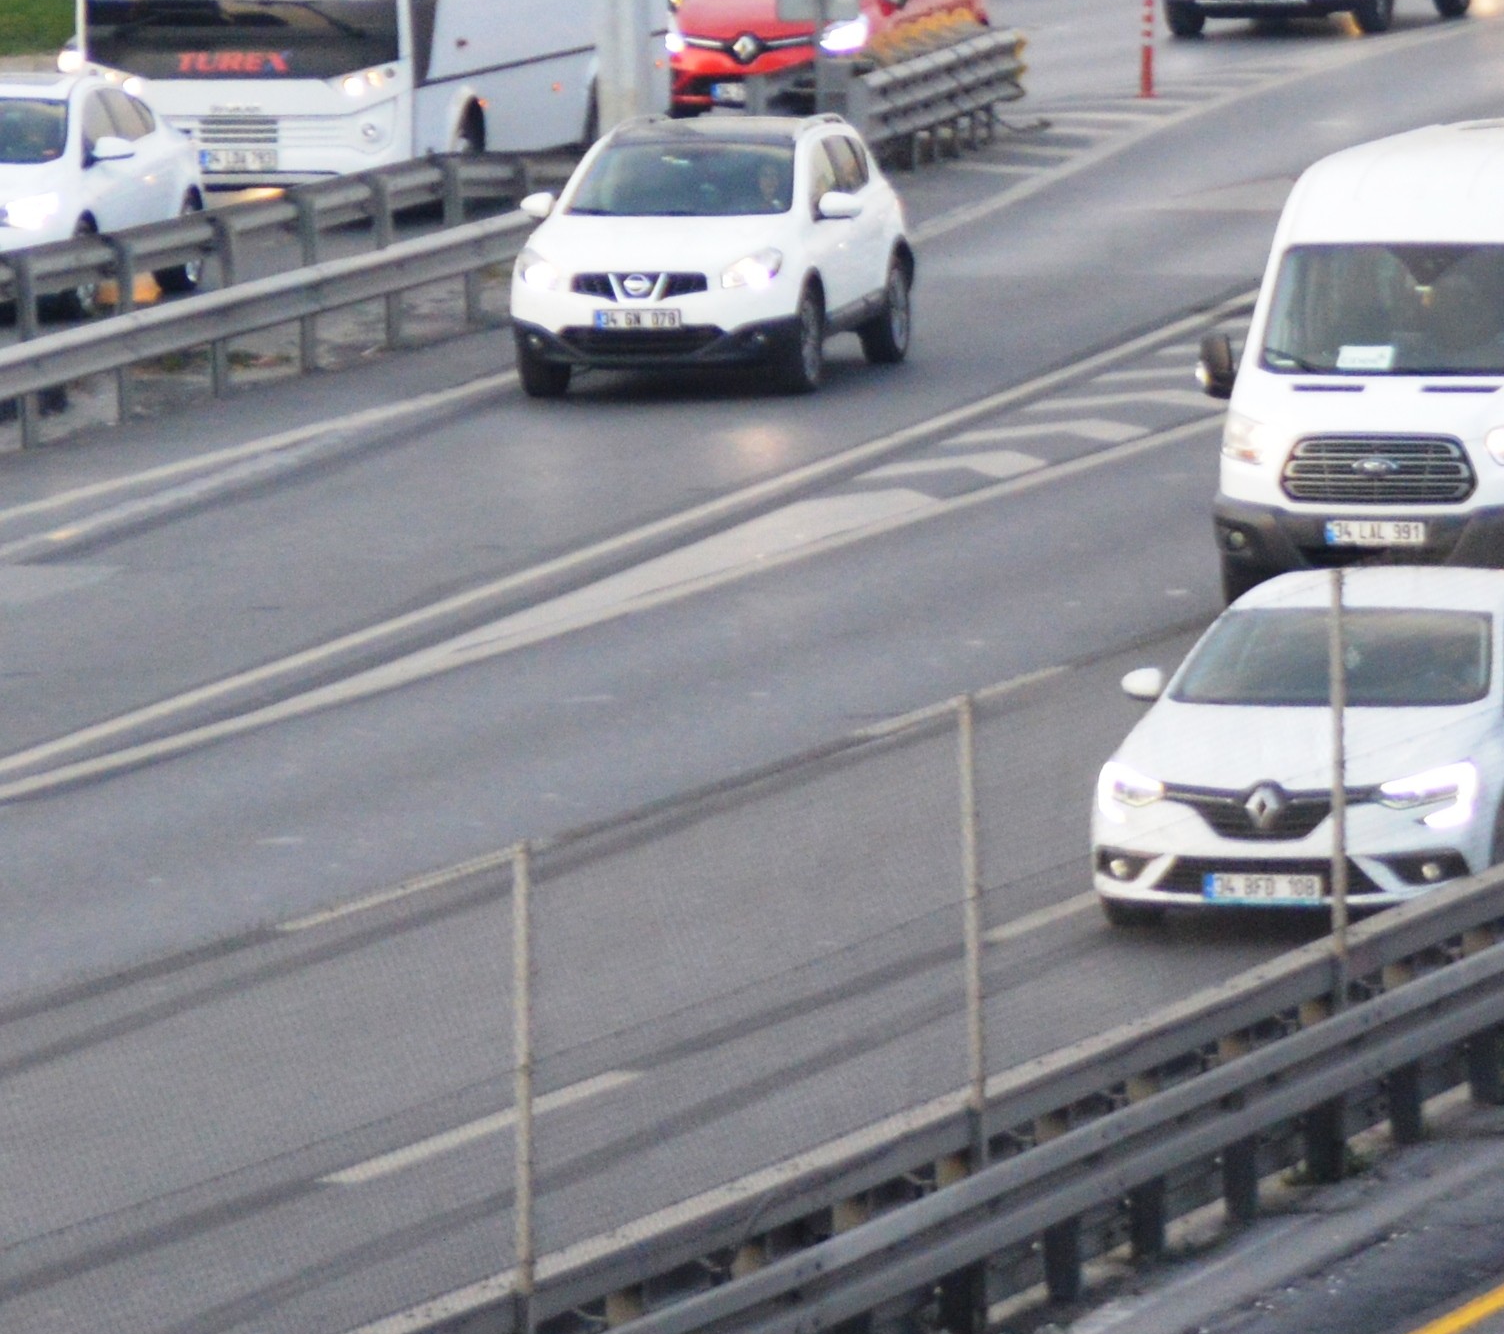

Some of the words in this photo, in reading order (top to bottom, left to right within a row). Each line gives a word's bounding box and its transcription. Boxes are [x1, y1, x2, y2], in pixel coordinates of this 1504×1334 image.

[177, 50, 292, 74] TUREX
[601, 309, 617, 326] 34
[1335, 524, 1353, 540] 34
[1358, 524, 1385, 541] LAL
[1214, 875, 1236, 897] 34
